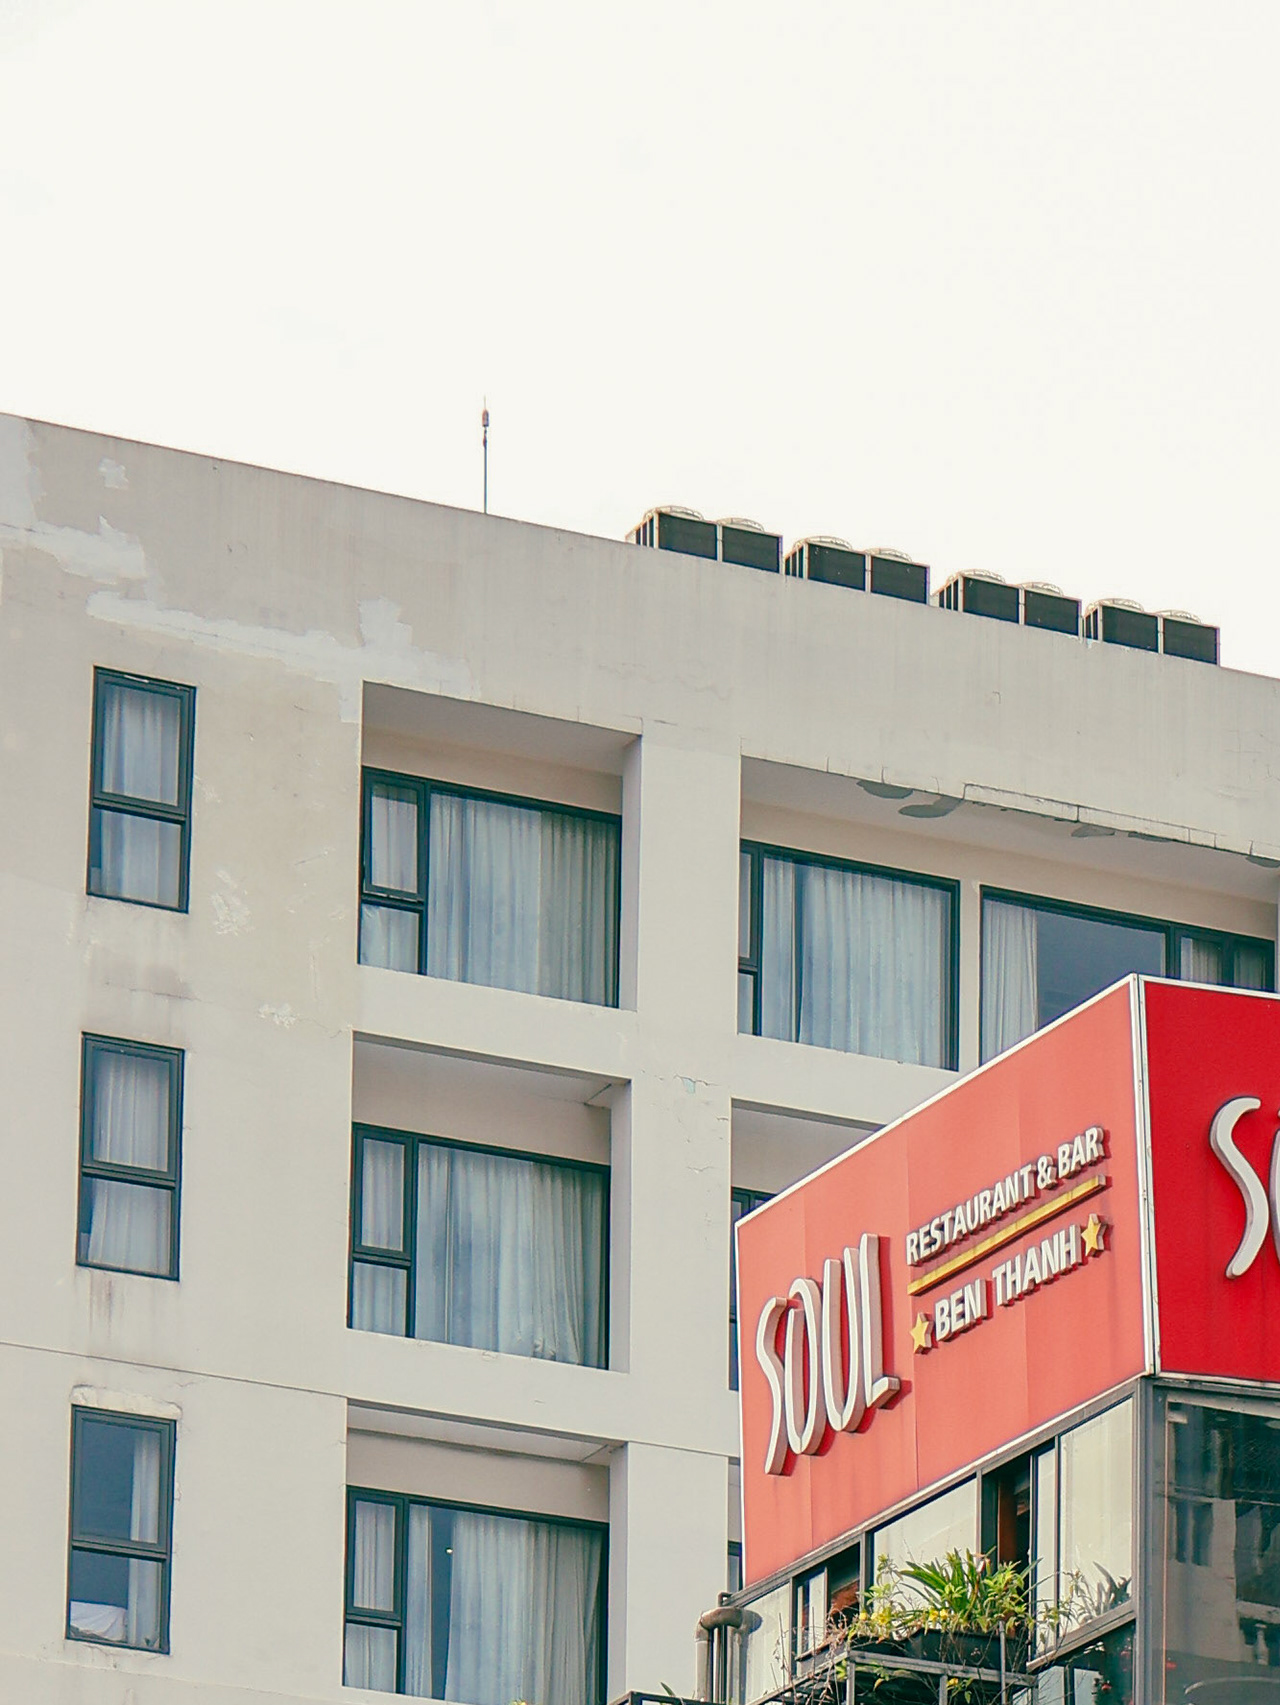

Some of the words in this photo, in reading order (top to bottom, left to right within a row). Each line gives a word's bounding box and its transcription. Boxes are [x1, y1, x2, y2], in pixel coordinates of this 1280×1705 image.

[907, 1163, 1035, 1266] RESTAURANT
[1037, 1156, 1057, 1189] &
[1058, 1127, 1105, 1179] BAR
[935, 1279, 987, 1342] BEN
[992, 1223, 1082, 1307] THANH
[756, 1234, 900, 1475] SOUL
